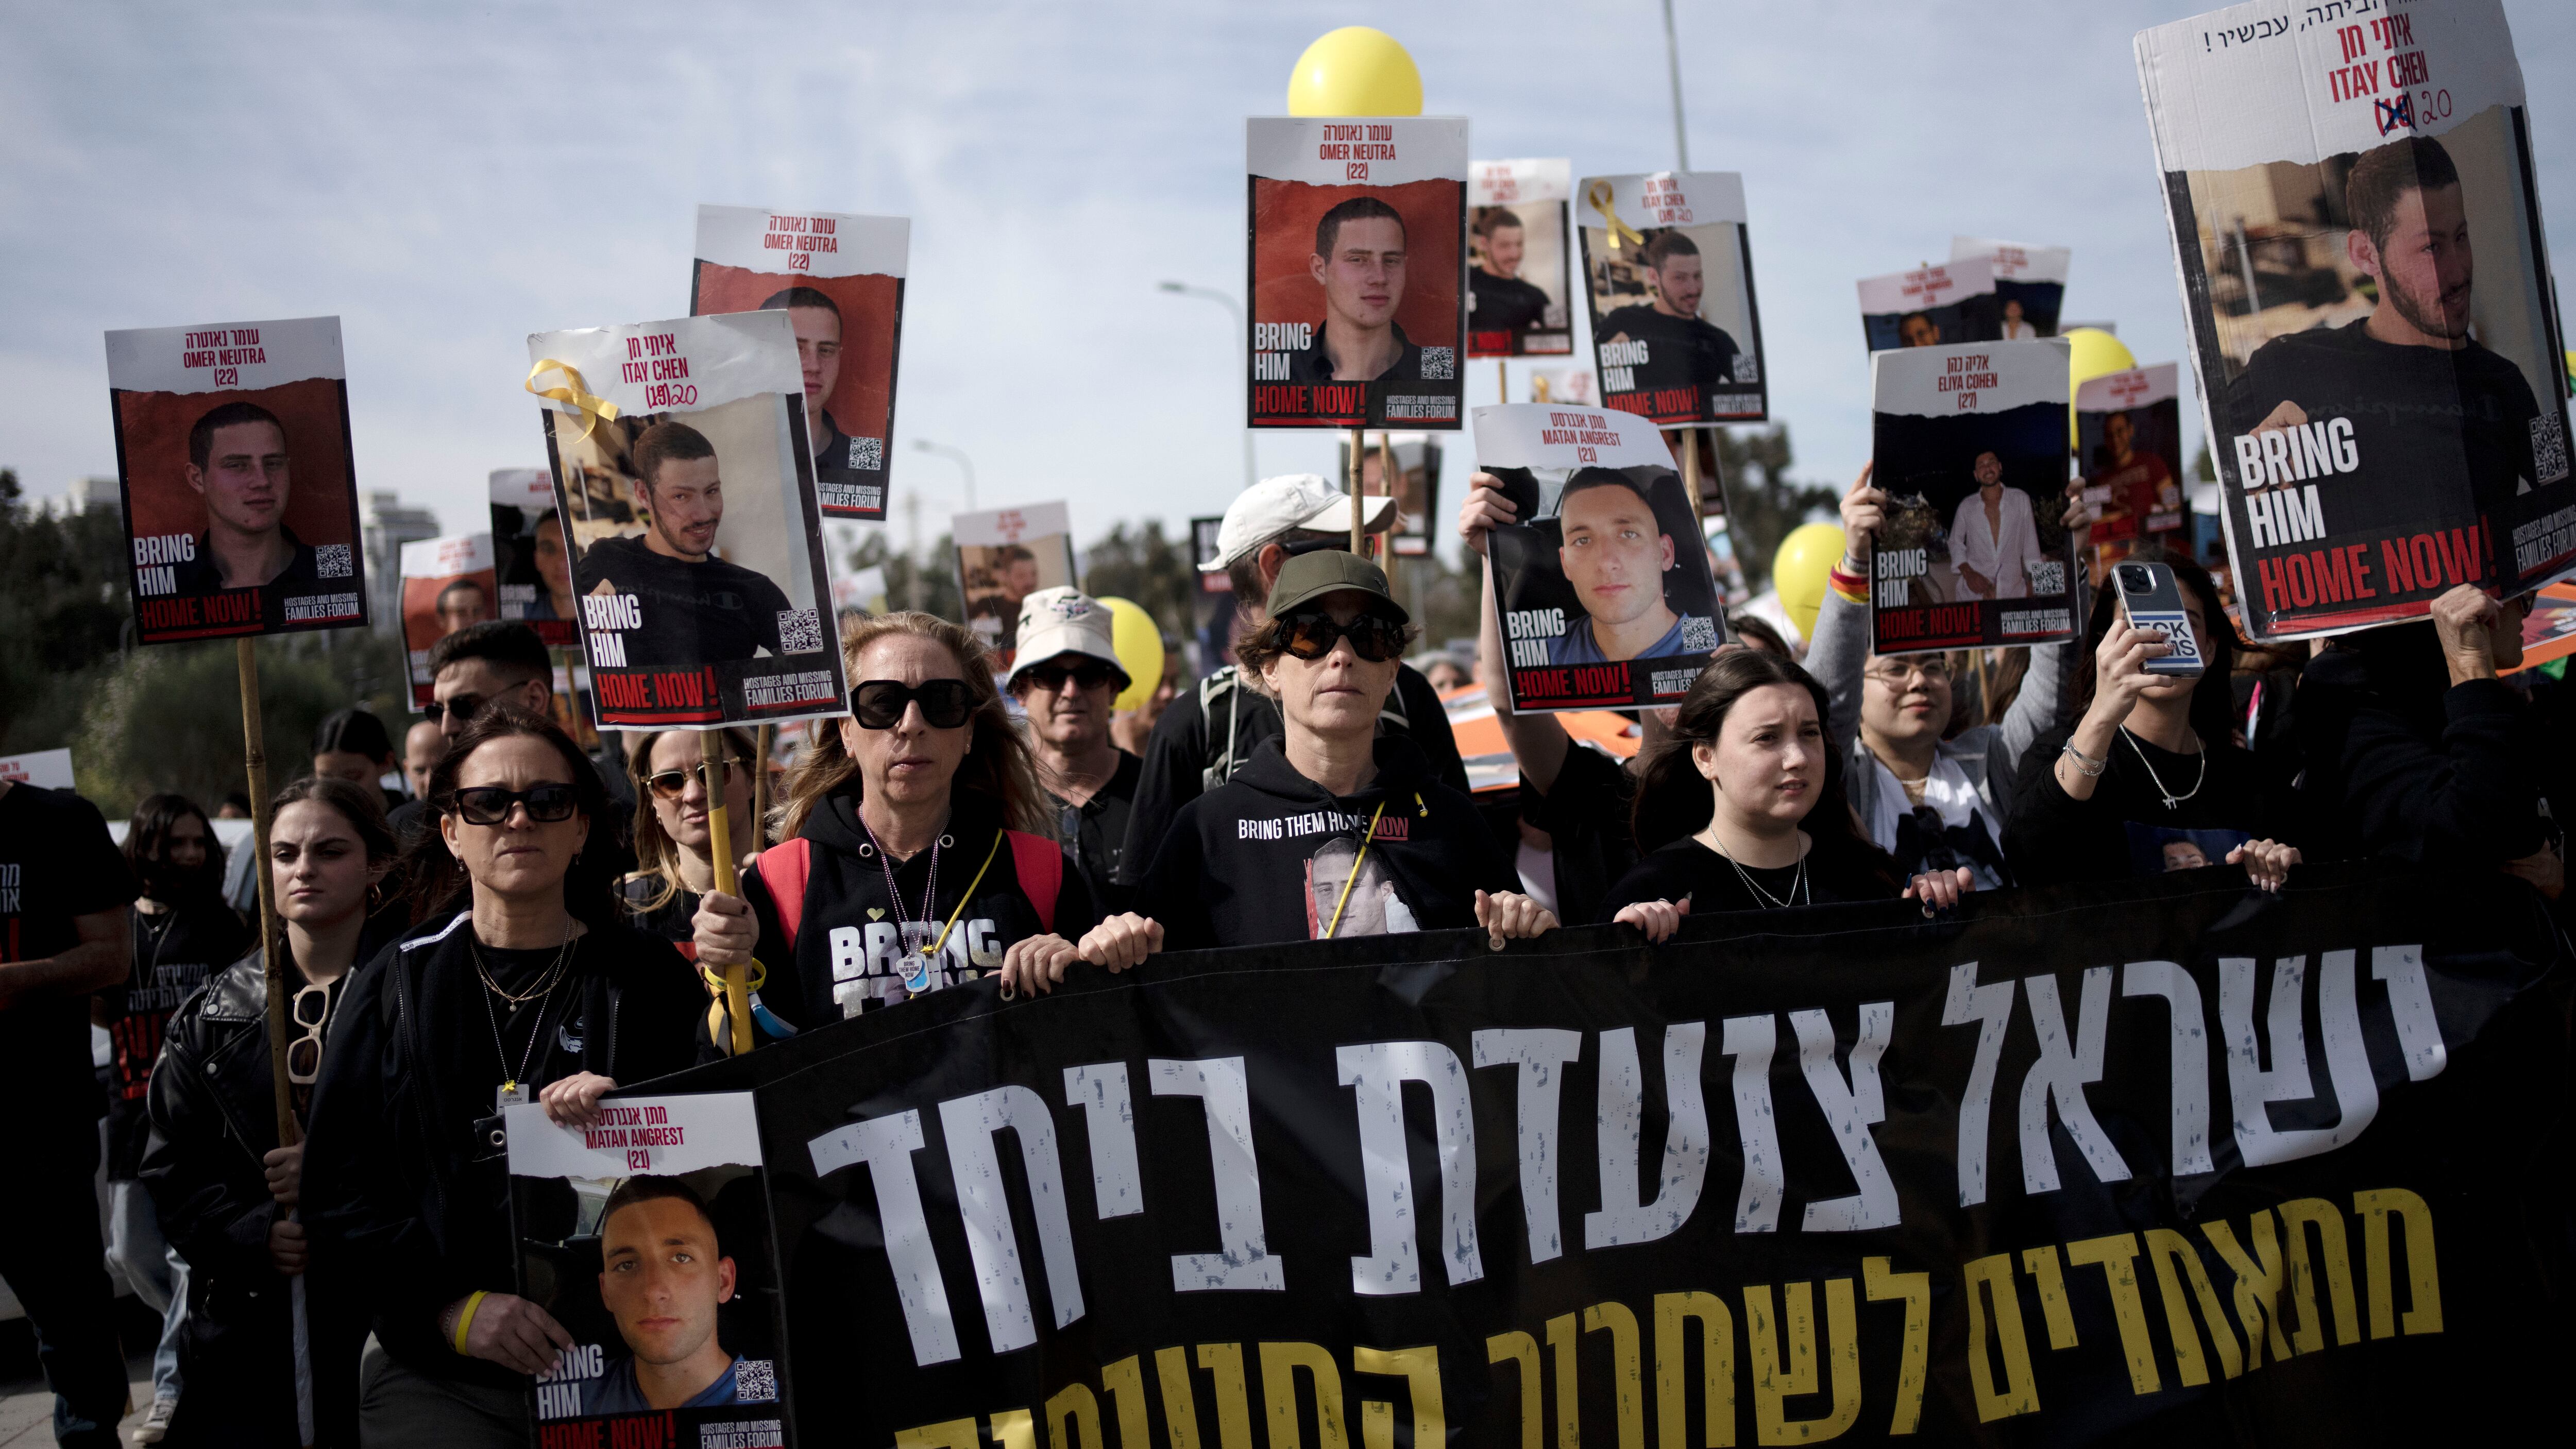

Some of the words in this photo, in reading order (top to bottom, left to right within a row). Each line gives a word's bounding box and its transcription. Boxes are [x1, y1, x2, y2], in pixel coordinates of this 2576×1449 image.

[2370, 13, 2414, 50] איתי
[2337, 24, 2366, 64] חן
[2329, 60, 2379, 103] ITAY
[2387, 50, 2429, 89] CHEN
[1324, 125, 1363, 141] נאוטרה
[1366, 125, 1392, 141] עומר
[1320, 144, 1350, 160] OMER
[1353, 144, 1396, 160] NEUTRA
[1347, 162, 1368, 180] (22)
[1664, 193, 1686, 206] CHEN
[770, 215, 807, 232] נאוטרה
[810, 217, 836, 234] עומר
[764, 233, 793, 250] OMER
[796, 235, 837, 253] NEUTRA
[789, 252, 809, 271] (22)
[185, 331, 228, 349] נאוטרה
[230, 329, 260, 346] עומר
[643, 333, 676, 354] איתי
[1255, 322, 1311, 351] BRING
[183, 351, 216, 368] OMER
[219, 348, 266, 366] NEUTRA
[626, 337, 641, 361] חן
[1599, 339, 1649, 368] BRING
[622, 361, 648, 383] ITAY
[652, 357, 689, 381] CHEN
[1255, 353, 1290, 380] HIM
[1947, 356, 1962, 374] כהן
[1965, 354, 1989, 371] אליה
[214, 367, 238, 387] (22)
[1603, 366, 1635, 393] HIM
[1939, 375, 1963, 392] ELIYA
[1966, 371, 1997, 390] COHEN
[1255, 386, 1308, 413] HOME
[1313, 383, 1366, 414] NOW!
[1386, 396, 1416, 405] HOSTAGES
[1416, 396, 1429, 405] AND
[1430, 396, 1456, 405] MISSING
[1607, 391, 1653, 415] HOME
[1958, 391, 1977, 411] (27)
[1386, 405, 1425, 418] FAMILIES
[1425, 405, 1456, 418] FORUM
[1588, 414, 1607, 430] מתן
[1542, 430, 1578, 445] MATAN
[1580, 431, 1621, 446] ANGREST
[1578, 446, 1597, 464] (21)
[2234, 416, 2359, 490] BRING
[818, 482, 842, 493] OSTAGES
[843, 484, 855, 494] AND
[856, 485, 881, 496] MISSING
[851, 494, 880, 509] FORUM
[2245, 484, 2327, 549] HIM
[2512, 519, 2541, 547] HOSTAGES
[2541, 514, 2554, 536] AND
[133, 534, 195, 566] BRING
[2515, 534, 2552, 573] FAMILIES
[1877, 548, 1927, 579] BRING
[2258, 543, 2376, 613] HOME
[2380, 514, 2497, 594] NOW!
[137, 566, 177, 596] HIM
[284, 596, 315, 607] HOSTAGES
[316, 595, 330, 605] AND
[330, 593, 358, 603] MISSING
[1878, 579, 1908, 609] HIM
[141, 598, 199, 629] HOME
[202, 589, 262, 625] NOW!
[285, 604, 326, 621] FAMILIES
[327, 602, 359, 618] FORUM
[582, 594, 642, 630] BRING
[1879, 609, 1924, 640] HOME
[1929, 602, 1981, 635] NOW!
[2001, 610, 2030, 620] HOSTAGES
[2031, 609, 2043, 619] AND
[2043, 608, 2070, 618] MISSING
[1506, 608, 1566, 639] BRING
[2002, 620, 2039, 635] FAMILIES
[2040, 617, 2070, 632] FORUM
[589, 633, 628, 668] HIM
[1511, 639, 1550, 668] HIM
[596, 673, 652, 708] HOME
[654, 666, 719, 708] NOW!
[743, 675, 782, 690] HOSTAGES
[782, 673, 798, 687] AND
[799, 670, 832, 685] MISSING
[1517, 668, 1571, 697] HOME
[1574, 662, 1632, 695] NOW!
[1651, 670, 1683, 681] HOSTAGES
[1683, 669, 1696, 678] AND
[1652, 679, 1692, 694] FAMILIES
[745, 685, 794, 707] FAMILIES
[795, 681, 835, 702] FORUM
[1239, 819, 1282, 840] BRING
[1285, 812, 1326, 837] THEM
[829, 918, 1004, 982] BRING
[1942, 944, 2448, 1208] ישראל
[643, 1106, 668, 1127] מתן
[585, 1129, 628, 1149] MATAN
[631, 1127, 684, 1147] ANGREST
[1335, 1001, 1901, 1295] צועדת
[627, 1149, 650, 1171] (21)
[807, 1055, 1286, 1367] ביחד
[1964, 1187, 2443, 1424] מתאחדים
[536, 1343, 603, 1384] RING
[1484, 1256, 1930, 1449] לשחרור
[537, 1383, 582, 1420] HIM
[700, 1422, 735, 1434] HOSTAGES
[735, 1421, 750, 1433] AND
[750, 1419, 781, 1432] MISSING
[701, 1433, 745, 1449] FAMILIES
[747, 1431, 783, 1447] FORUM
